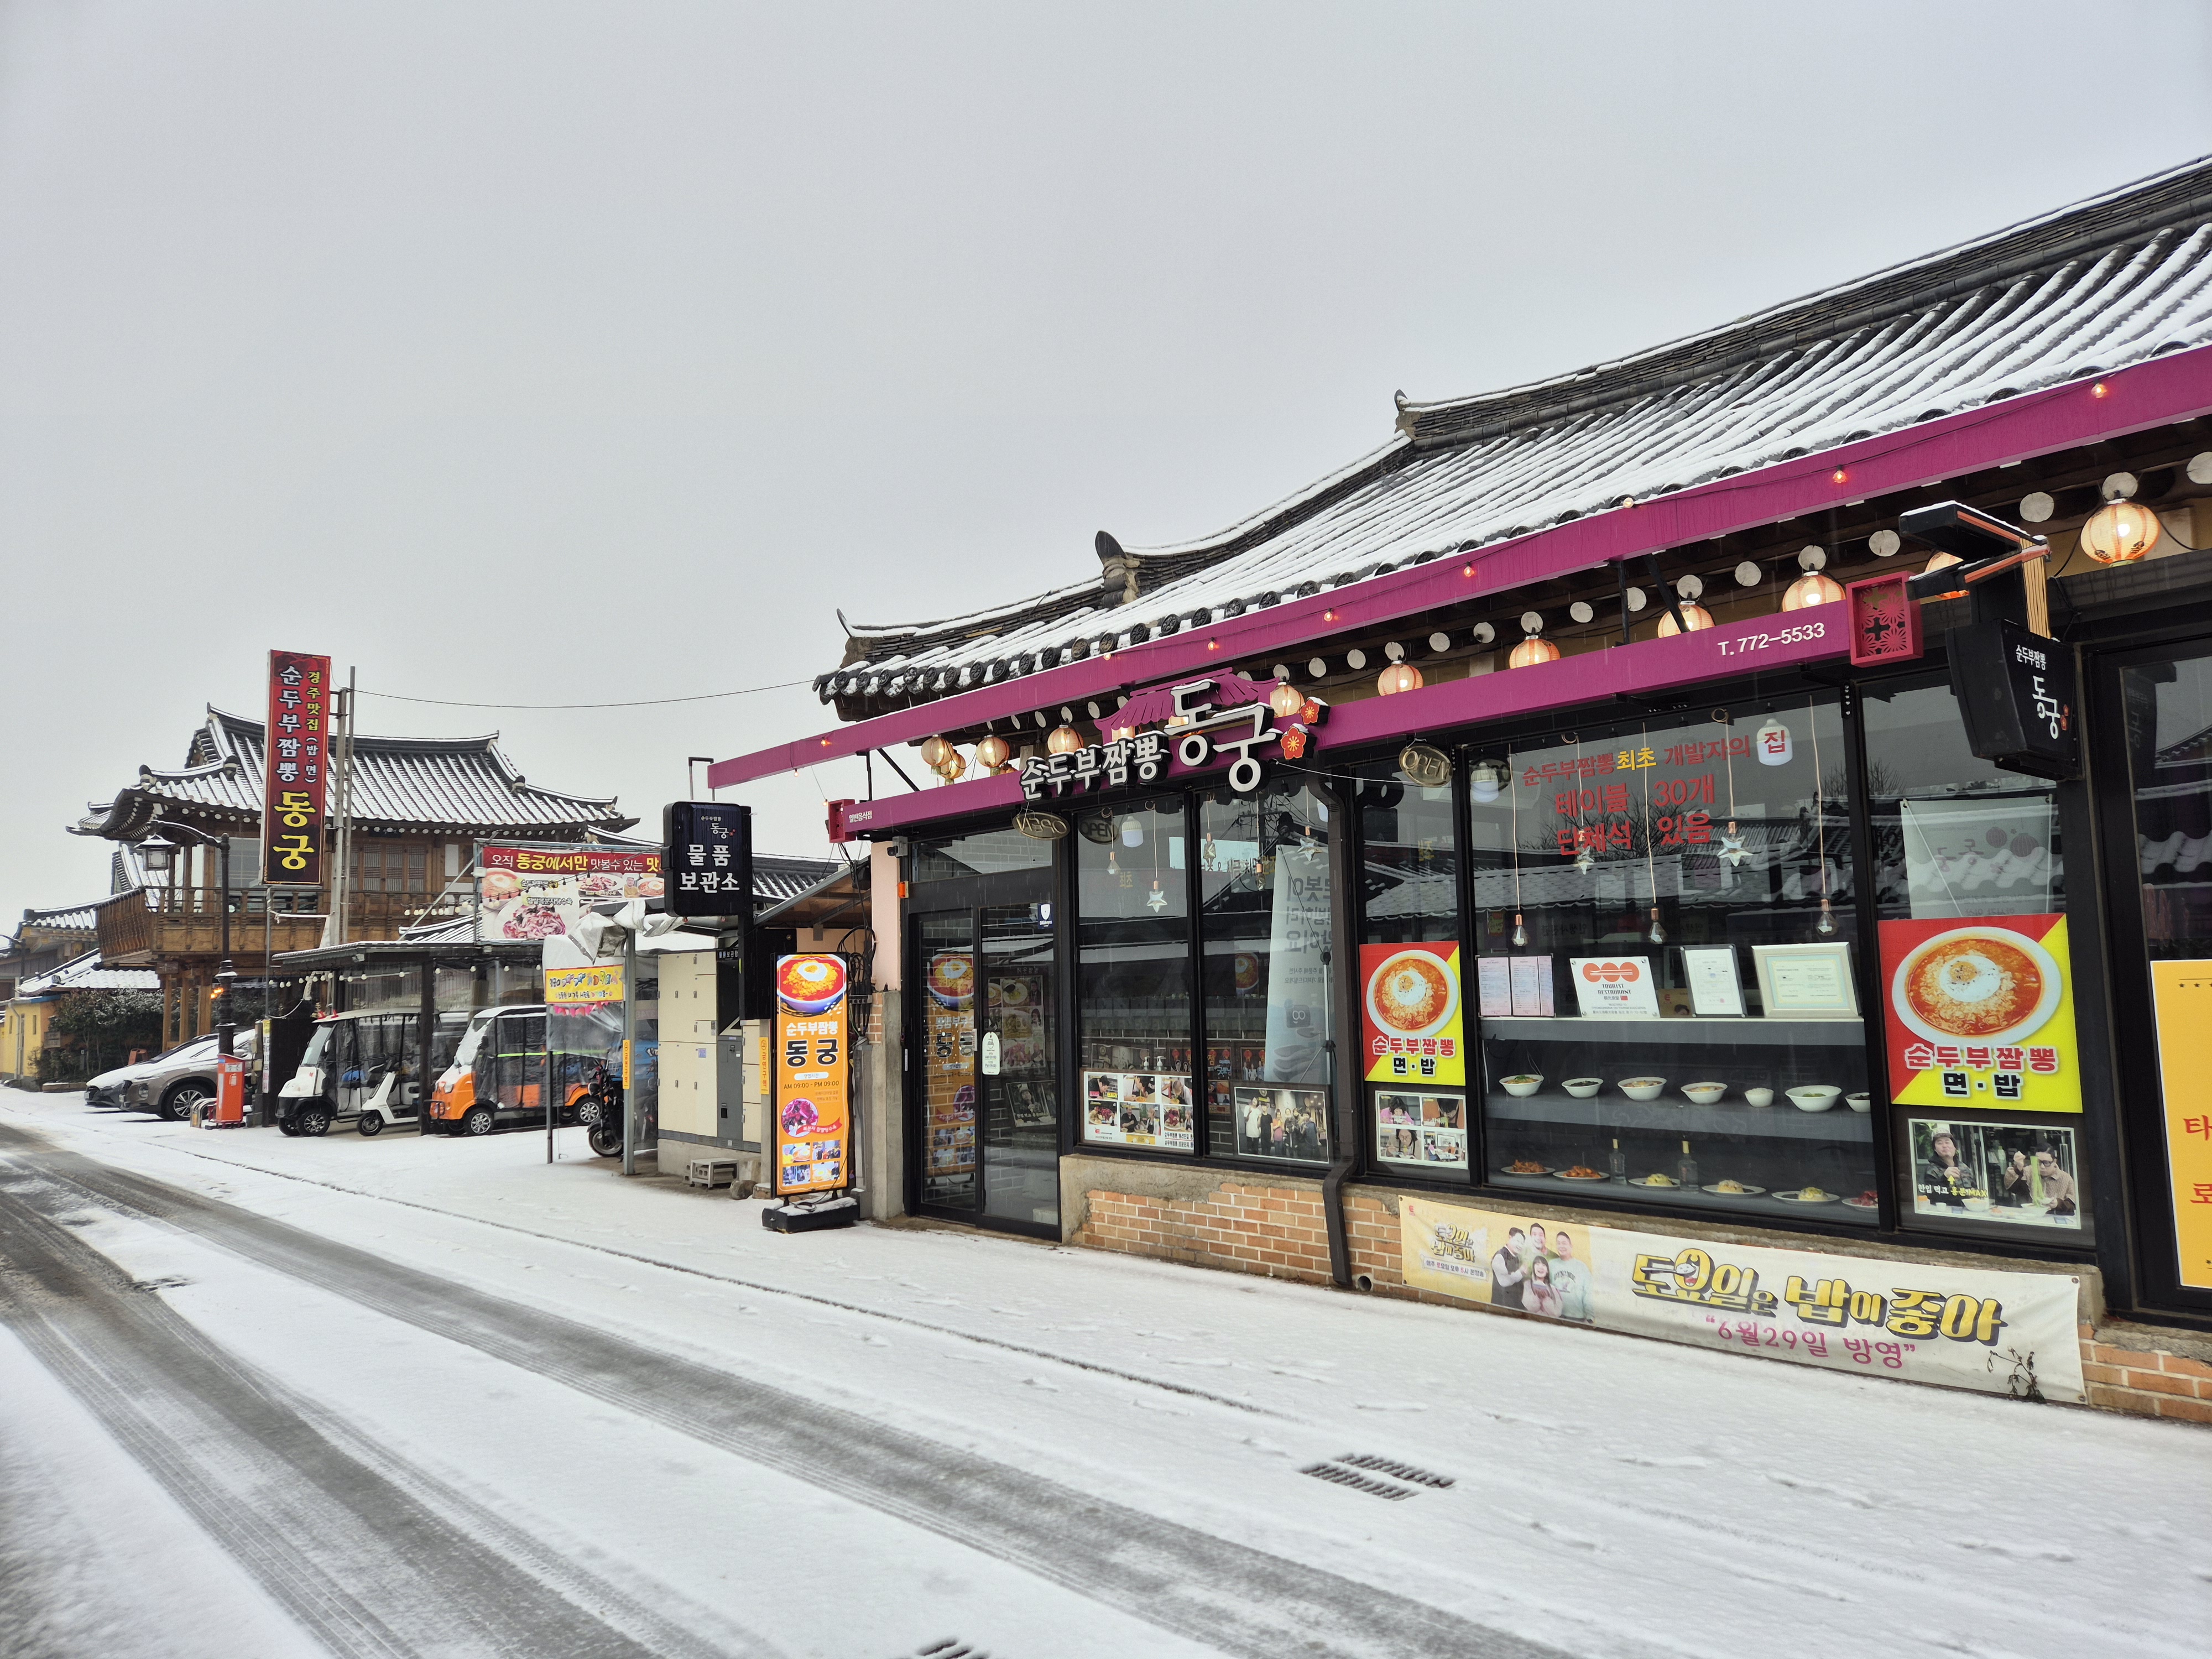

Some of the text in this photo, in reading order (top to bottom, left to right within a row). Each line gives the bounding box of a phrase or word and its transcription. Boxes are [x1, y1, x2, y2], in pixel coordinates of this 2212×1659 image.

[2015, 644, 2047, 671] 순두부짬뽕
[306, 671, 322, 732] 경주맛집
[2032, 675, 2061, 740] 동궁
[276, 665, 303, 782] 순두부짬뽕
[1164, 679, 1279, 792] 동궁
[1020, 735, 1165, 801] 순두부짬뽕
[1402, 750, 1452, 780] OPEN
[1617, 746, 1658, 771] 최초
[1663, 735, 1751, 766] 개발자의
[1764, 729, 1786, 754] 집
[849, 810, 872, 823] 일반음식점
[1555, 773, 1714, 818] 테이블 30개
[272, 791, 316, 870] 동궁
[710, 822, 729, 839] 동궁
[1557, 812, 1714, 857] 단체석 있음
[491, 852, 662, 873] 오직 동궁에서만 맛볼수 있는 맛
[679, 871, 740, 894] 보관소
[786, 1021, 838, 1037] 순두부짬뽕
[1373, 1036, 1455, 1057] 순두부짬뽕
[1906, 1045, 2057, 1072] 순두부짬뽕
[1918, 1183, 1932, 1194] 한입
[1933, 1185, 1949, 1194] 먹고
[1631, 1248, 1780, 1318] 토요일은
[1784, 1275, 2008, 1347] 밥이 좋아
